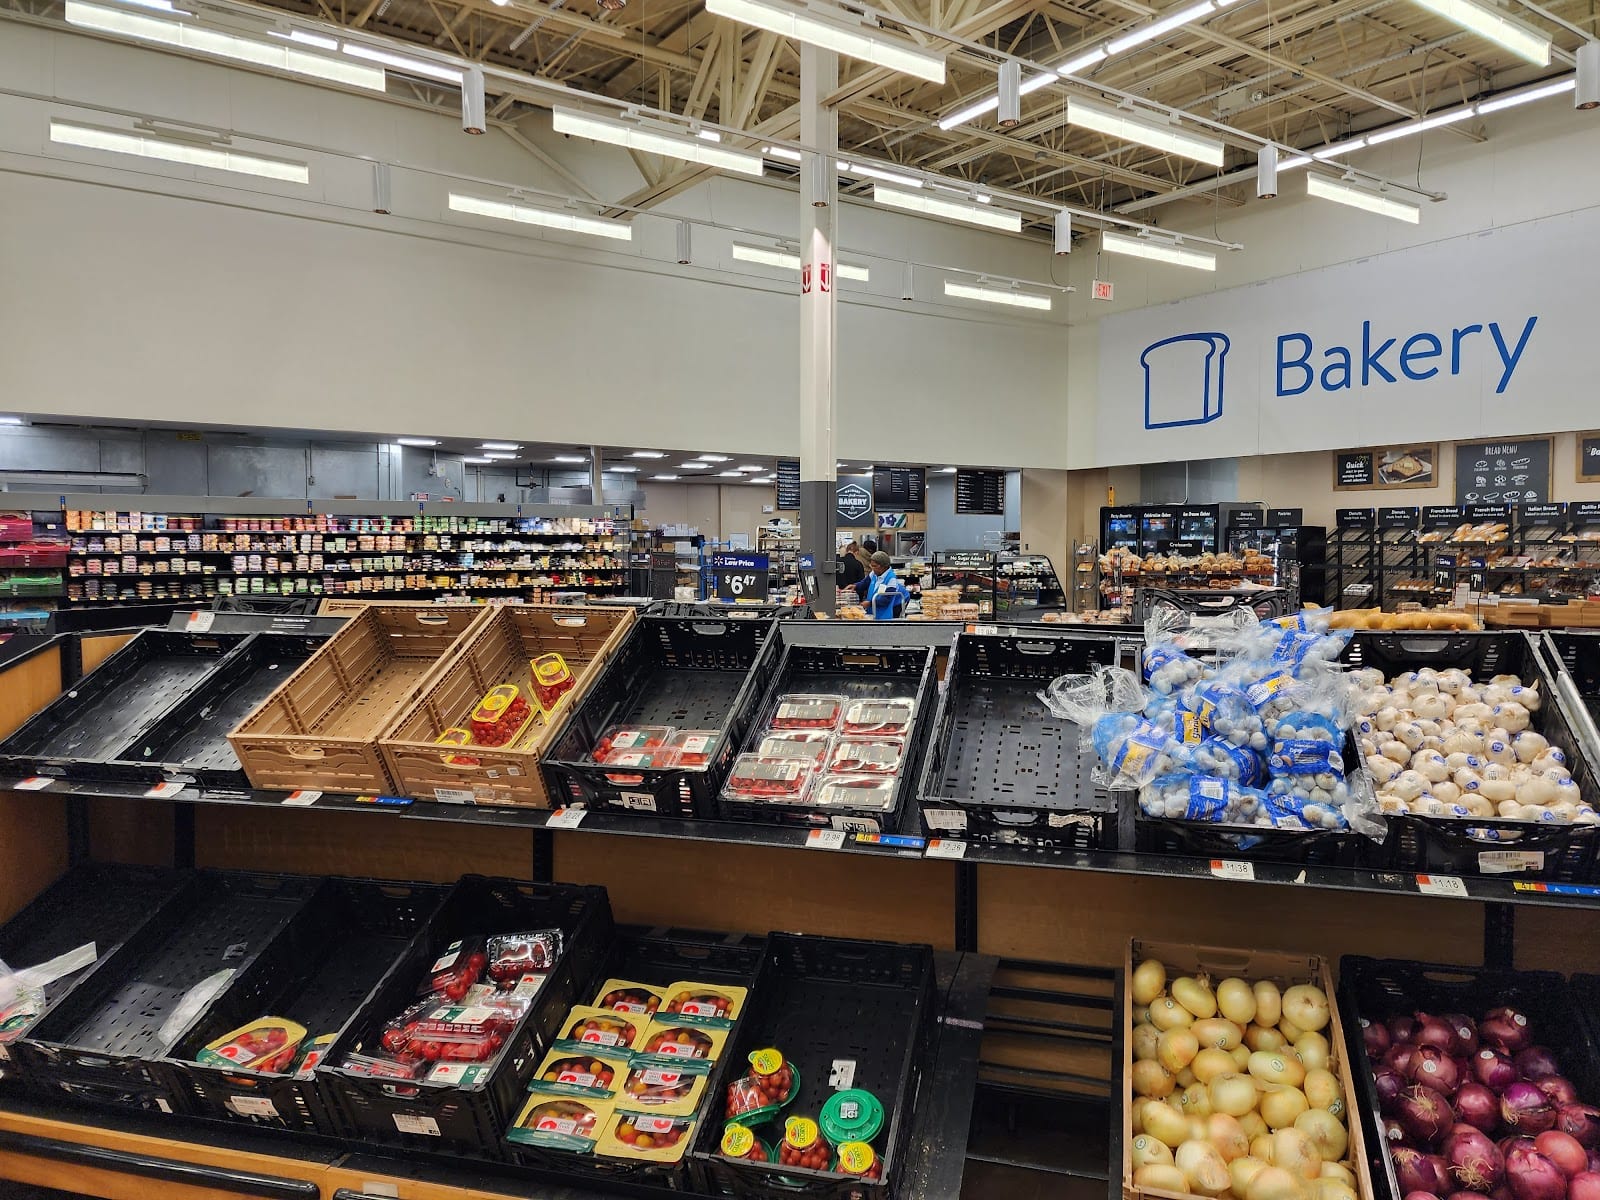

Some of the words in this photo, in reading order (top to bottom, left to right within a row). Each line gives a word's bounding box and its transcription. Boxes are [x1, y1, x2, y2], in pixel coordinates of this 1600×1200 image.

[1096, 283, 1111, 297] EXIT
[1275, 315, 1538, 397] Bakery
[1485, 446, 1501, 455] BREAD
[1502, 445, 1518, 455] MENU
[1345, 460, 1364, 469] Quick
[1226, 864, 1247, 873] $1.38
[1433, 879, 1459, 889] $1.18
